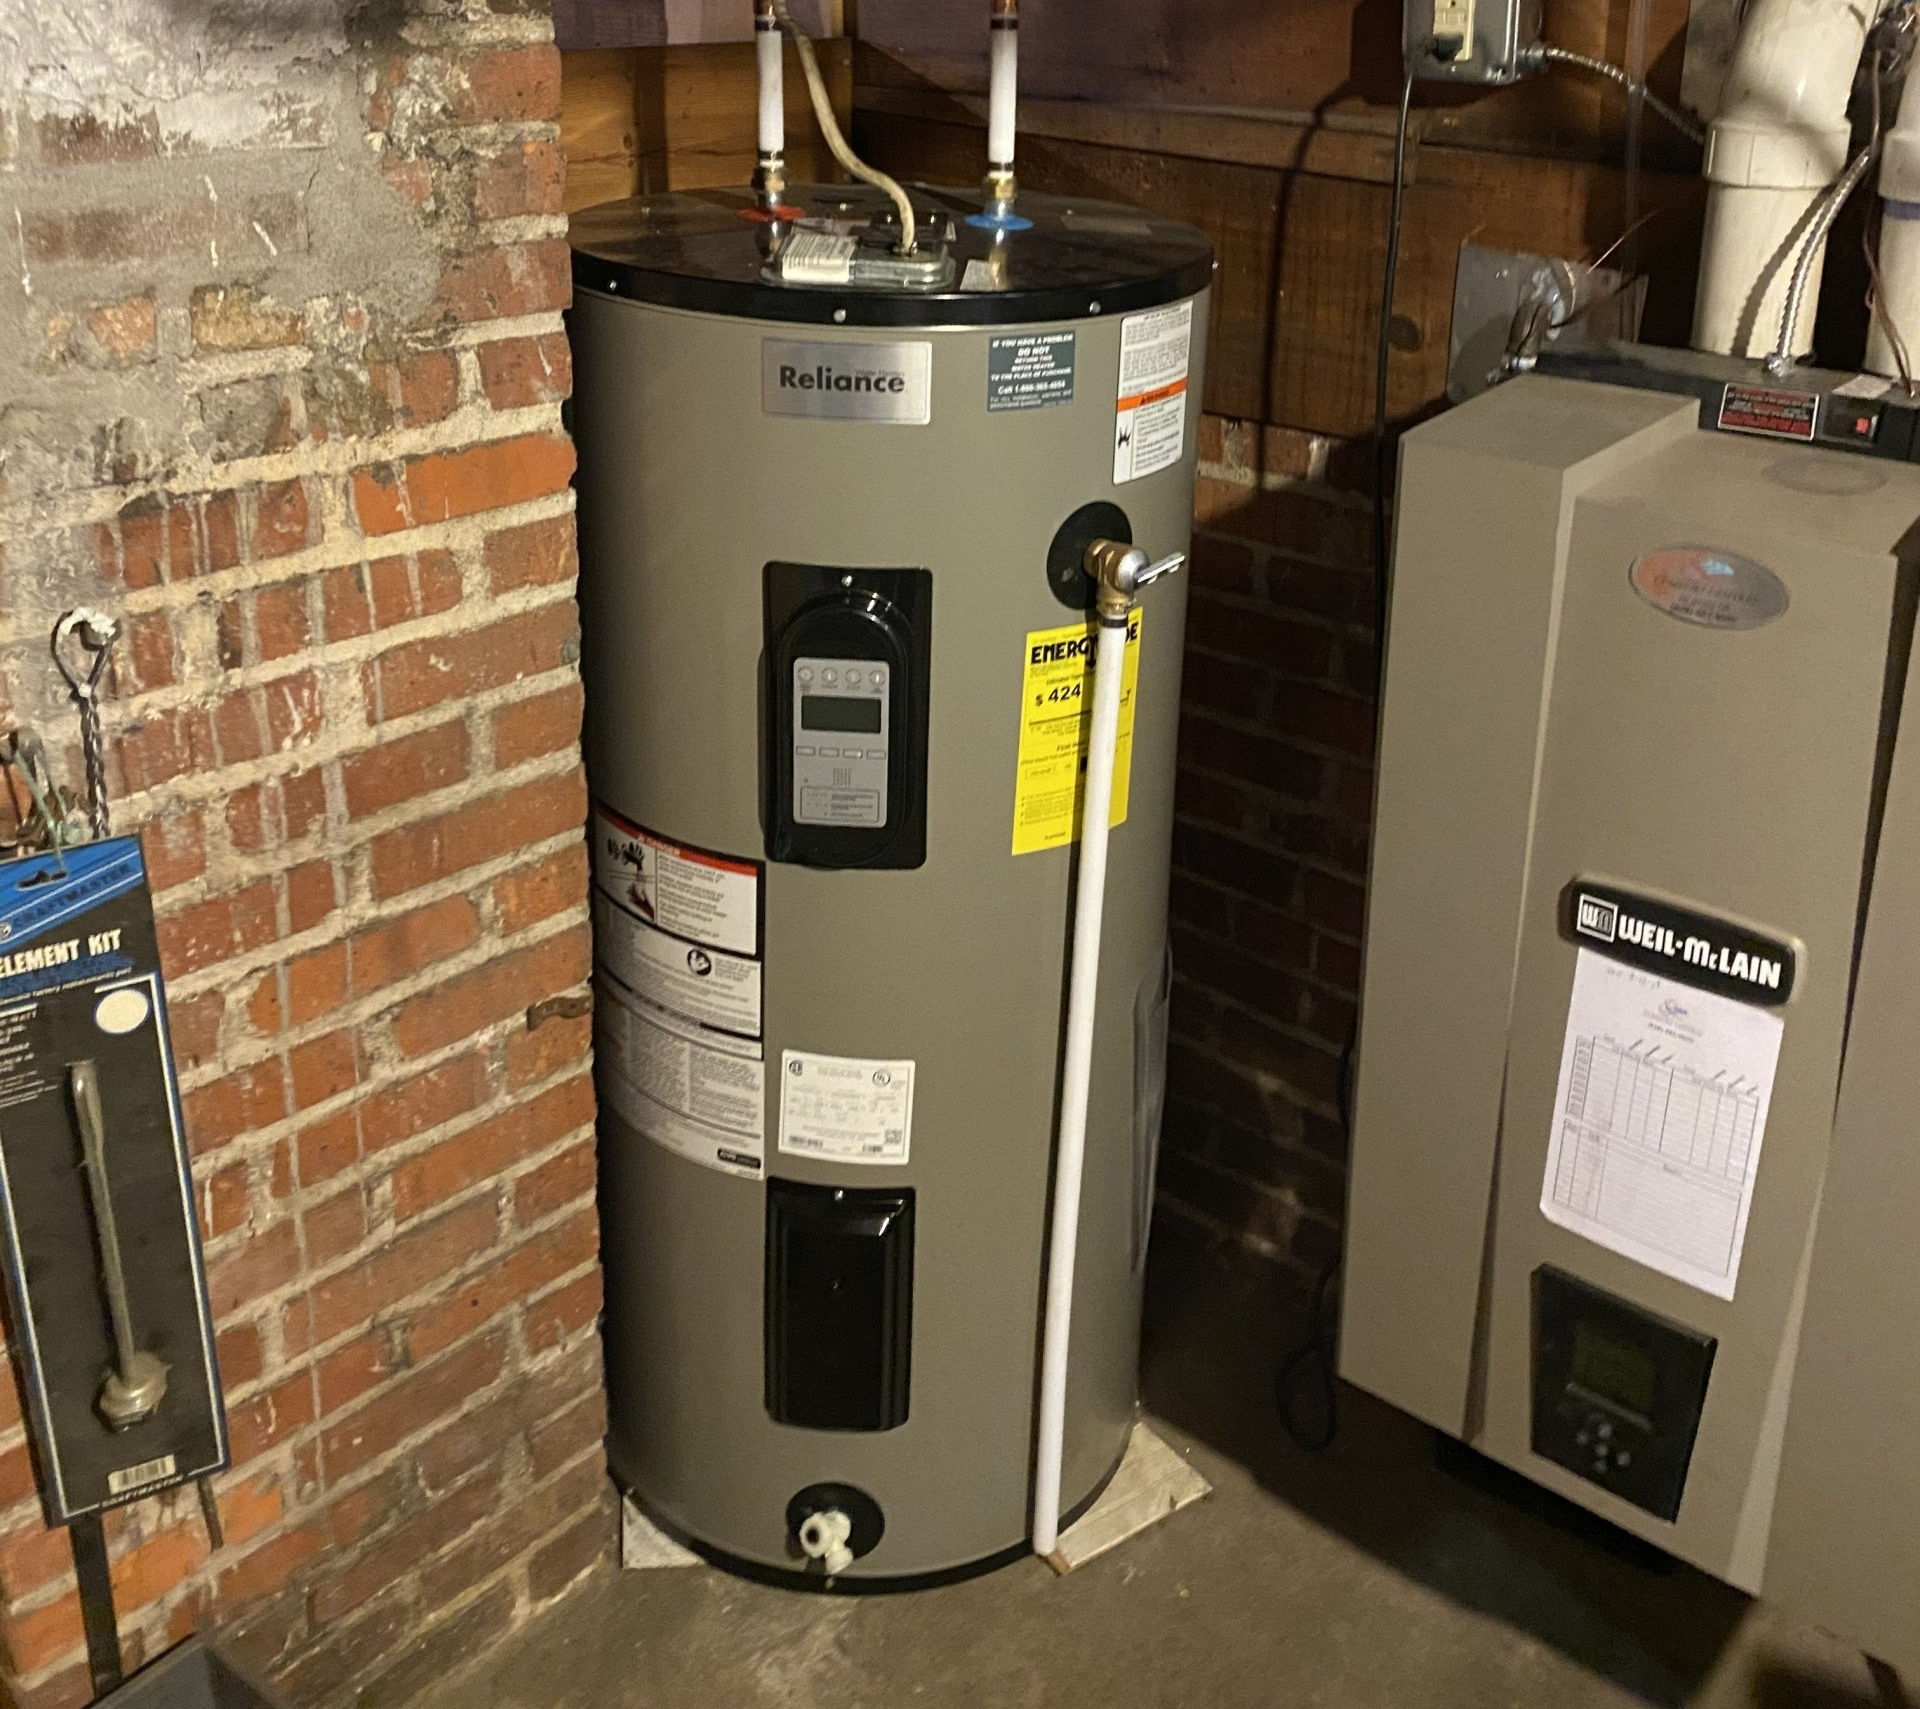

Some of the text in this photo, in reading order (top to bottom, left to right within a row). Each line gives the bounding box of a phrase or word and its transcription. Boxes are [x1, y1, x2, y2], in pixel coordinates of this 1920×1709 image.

[1001, 338, 1017, 348] YOU
[1017, 337, 1036, 347] HAVE
[1043, 333, 1074, 345] PROBLEM
[1018, 345, 1051, 357] DO NOT
[779, 365, 905, 394] Reliance
[998, 384, 1014, 395] Call
[1048, 682, 1081, 703] 424
[88, 928, 122, 957] KIT
